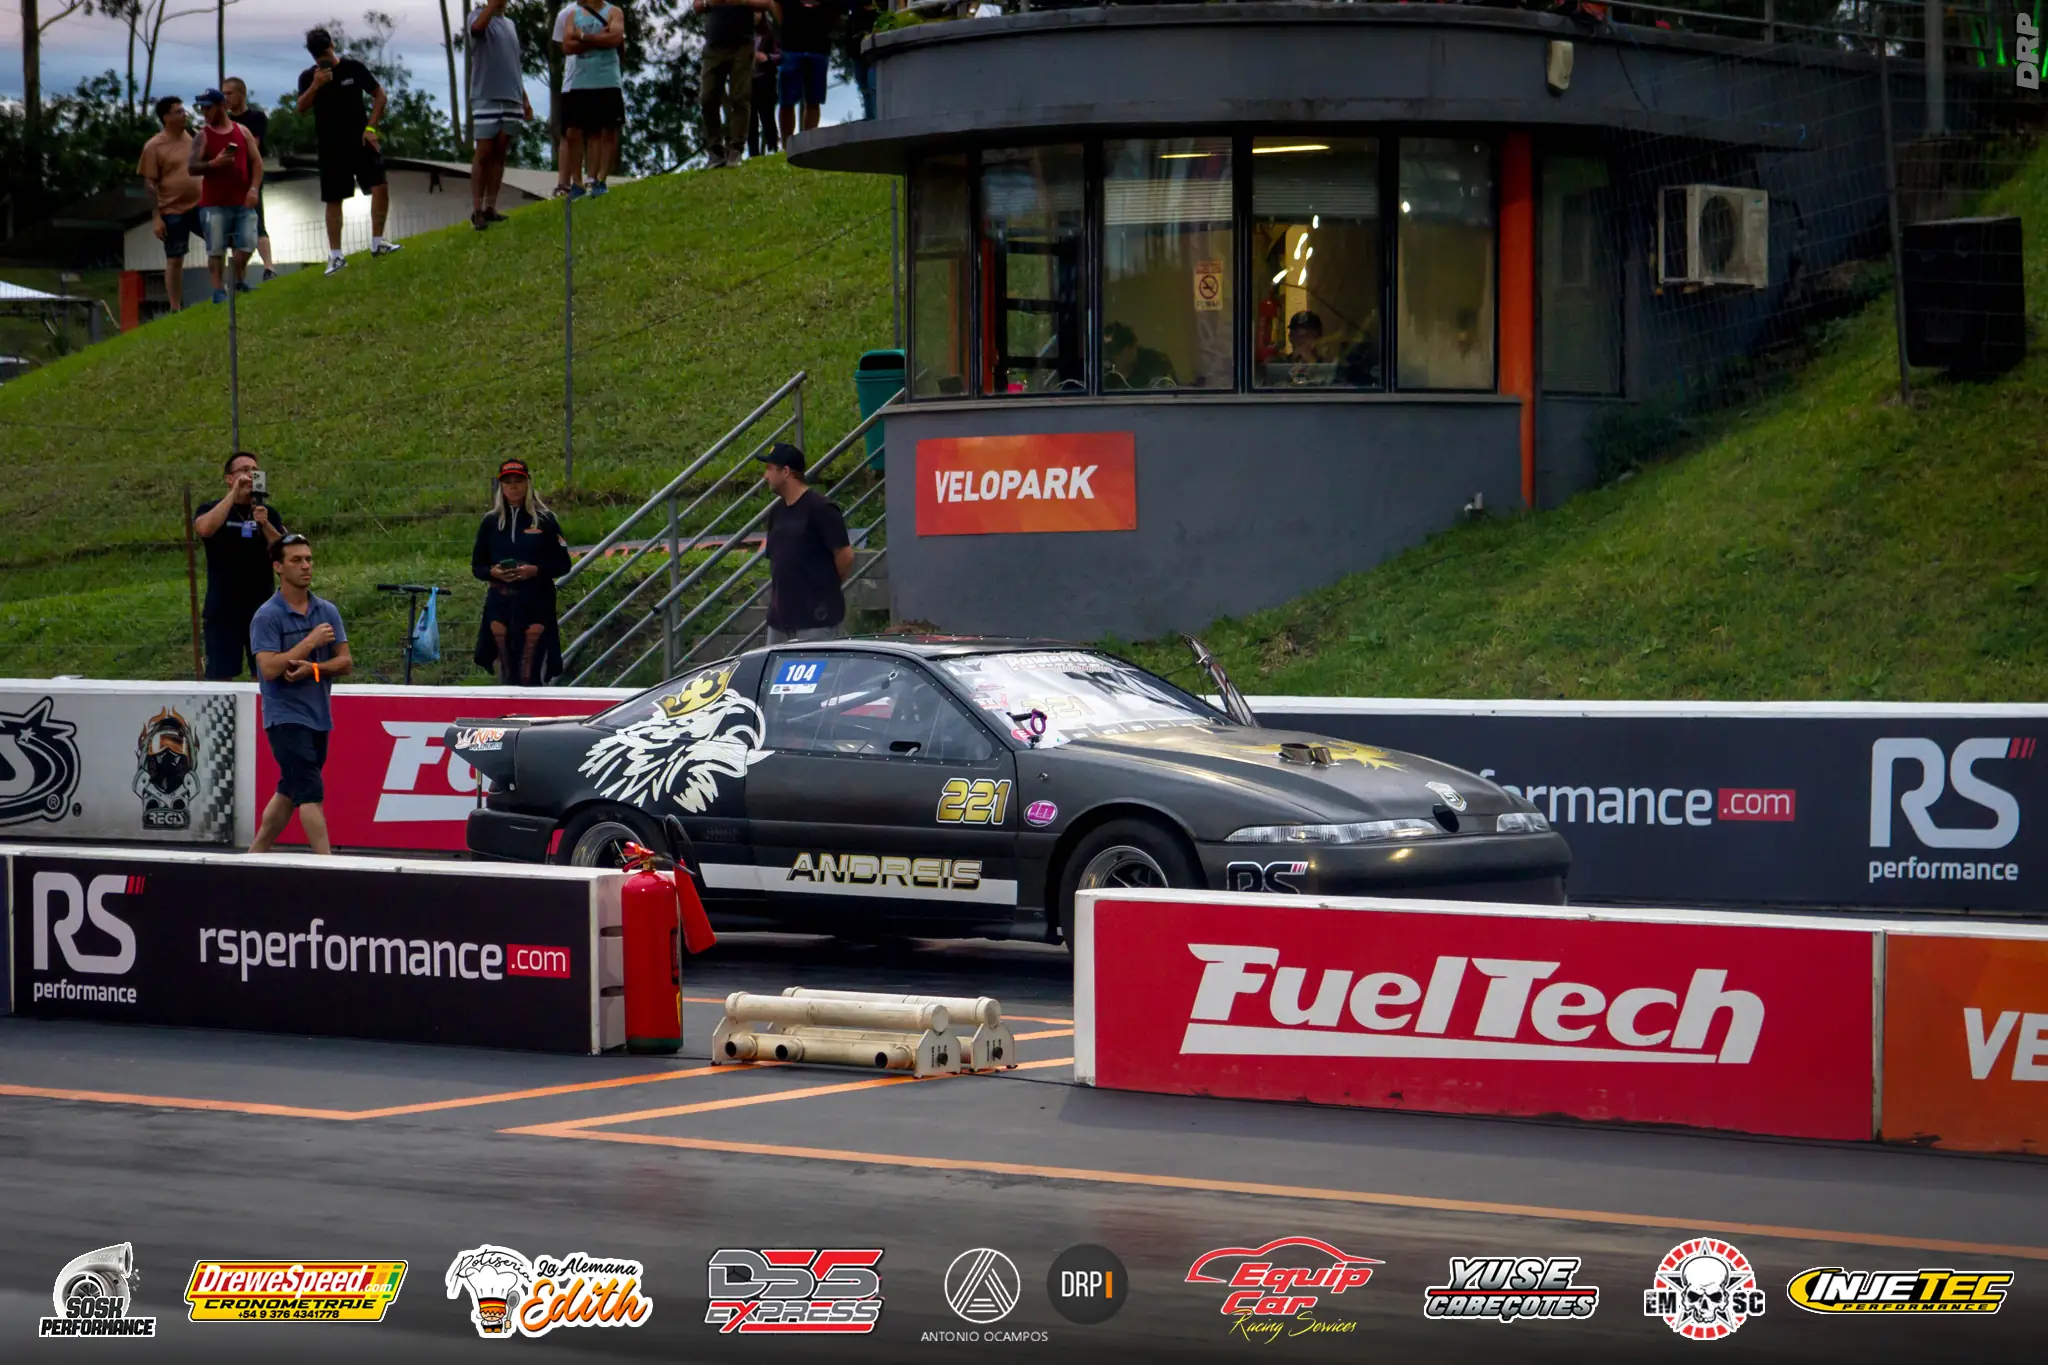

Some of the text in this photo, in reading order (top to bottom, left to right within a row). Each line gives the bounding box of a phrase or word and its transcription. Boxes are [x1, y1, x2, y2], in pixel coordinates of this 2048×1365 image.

[934, 464, 1099, 504] VELOPARK
[785, 664, 818, 682] 104
[936, 777, 1012, 825] 221
[1869, 737, 2022, 850] RS
[786, 852, 983, 891] ANDREIS
[1868, 855, 2020, 884] performance
[32, 871, 137, 975] RS
[33, 978, 138, 1004] performance
[1187, 943, 1766, 1065] FuelTech
[1963, 1007, 2048, 1081] VE
